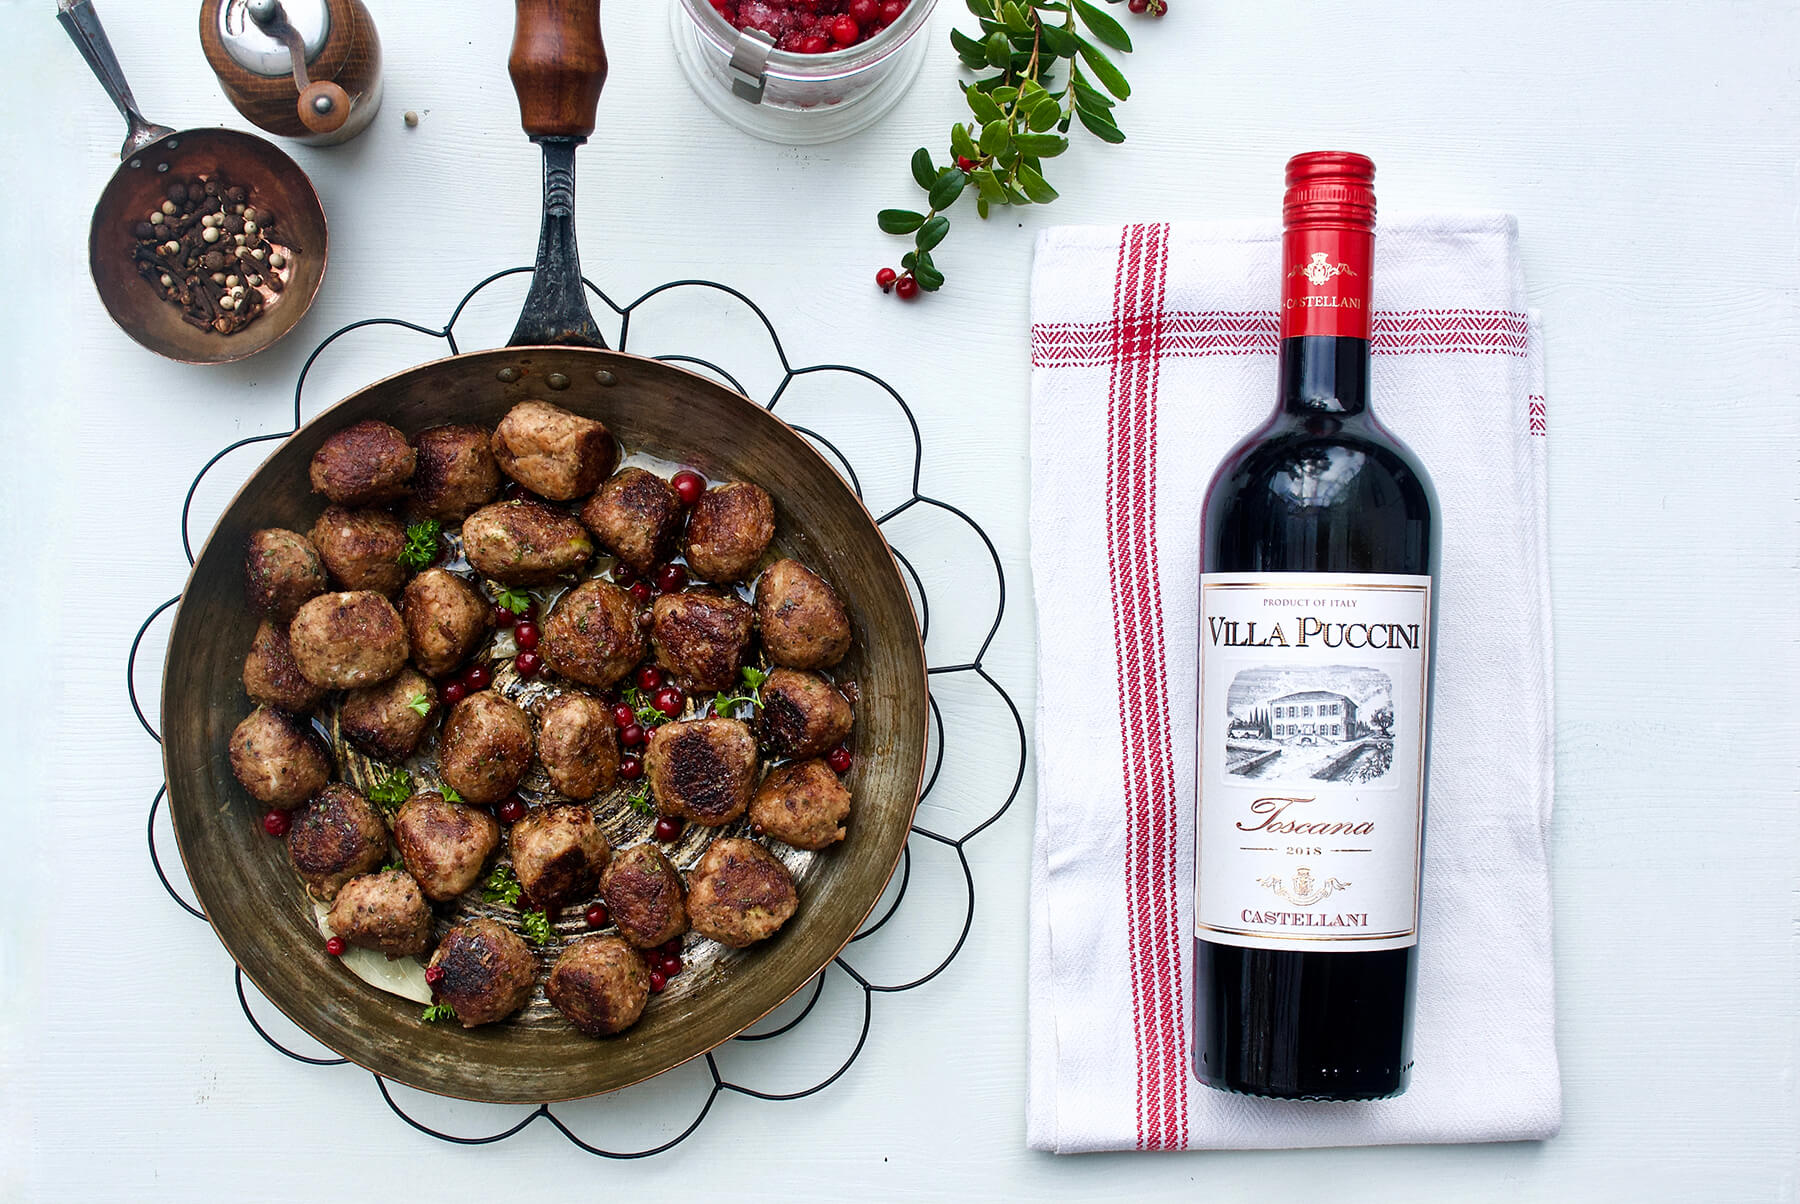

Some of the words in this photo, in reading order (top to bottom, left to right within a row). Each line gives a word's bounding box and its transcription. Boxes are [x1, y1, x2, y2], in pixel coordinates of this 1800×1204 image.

[1286, 296, 1361, 309] CASTELLANI
[1263, 598, 1310, 608] PRODUCT
[1313, 599, 1326, 608] OF
[1330, 599, 1358, 608] ITALY
[1235, 797, 1375, 836] Toscana
[1286, 846, 1322, 856] 2018
[1240, 908, 1369, 927] CASTELLANI
